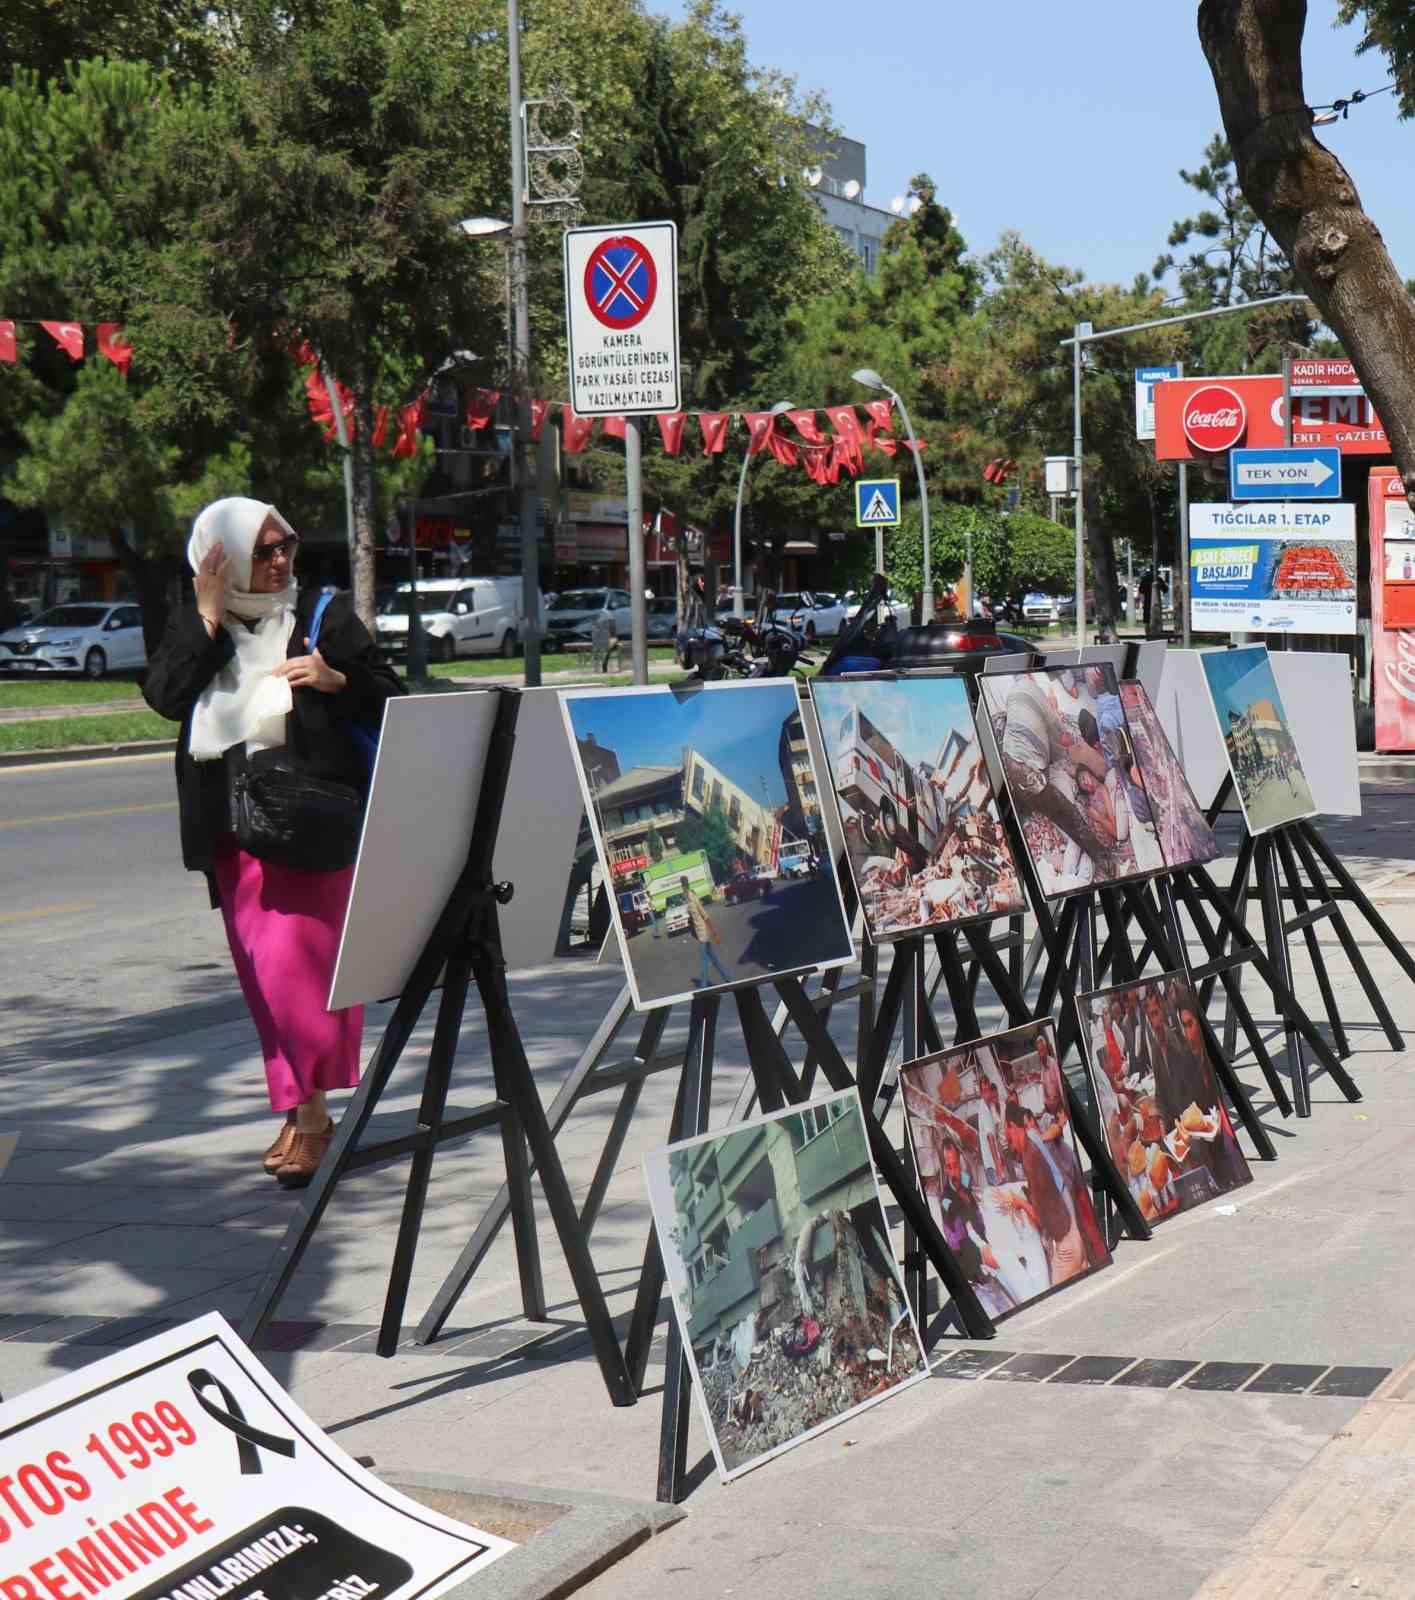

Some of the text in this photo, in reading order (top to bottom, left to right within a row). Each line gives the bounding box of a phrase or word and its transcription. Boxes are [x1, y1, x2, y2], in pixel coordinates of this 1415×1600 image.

[603, 334, 642, 348] KAMERA
[578, 350, 670, 368] GÖRÜNTÜLERİNDEN
[1293, 363, 1356, 376] KADİR HOCA
[576, 370, 673, 388] PARK YASAĞI CEZASI
[588, 390, 663, 407] YAZILMAKTADIR
[1186, 407, 1241, 429] Coca-Cola
[1335, 430, 1385, 441] GAZETE
[1245, 470, 1272, 479] TEK
[1212, 511, 1331, 525] TIĞCILAR 1. ETAP
[0, 1400, 197, 1543] TOS 1999
